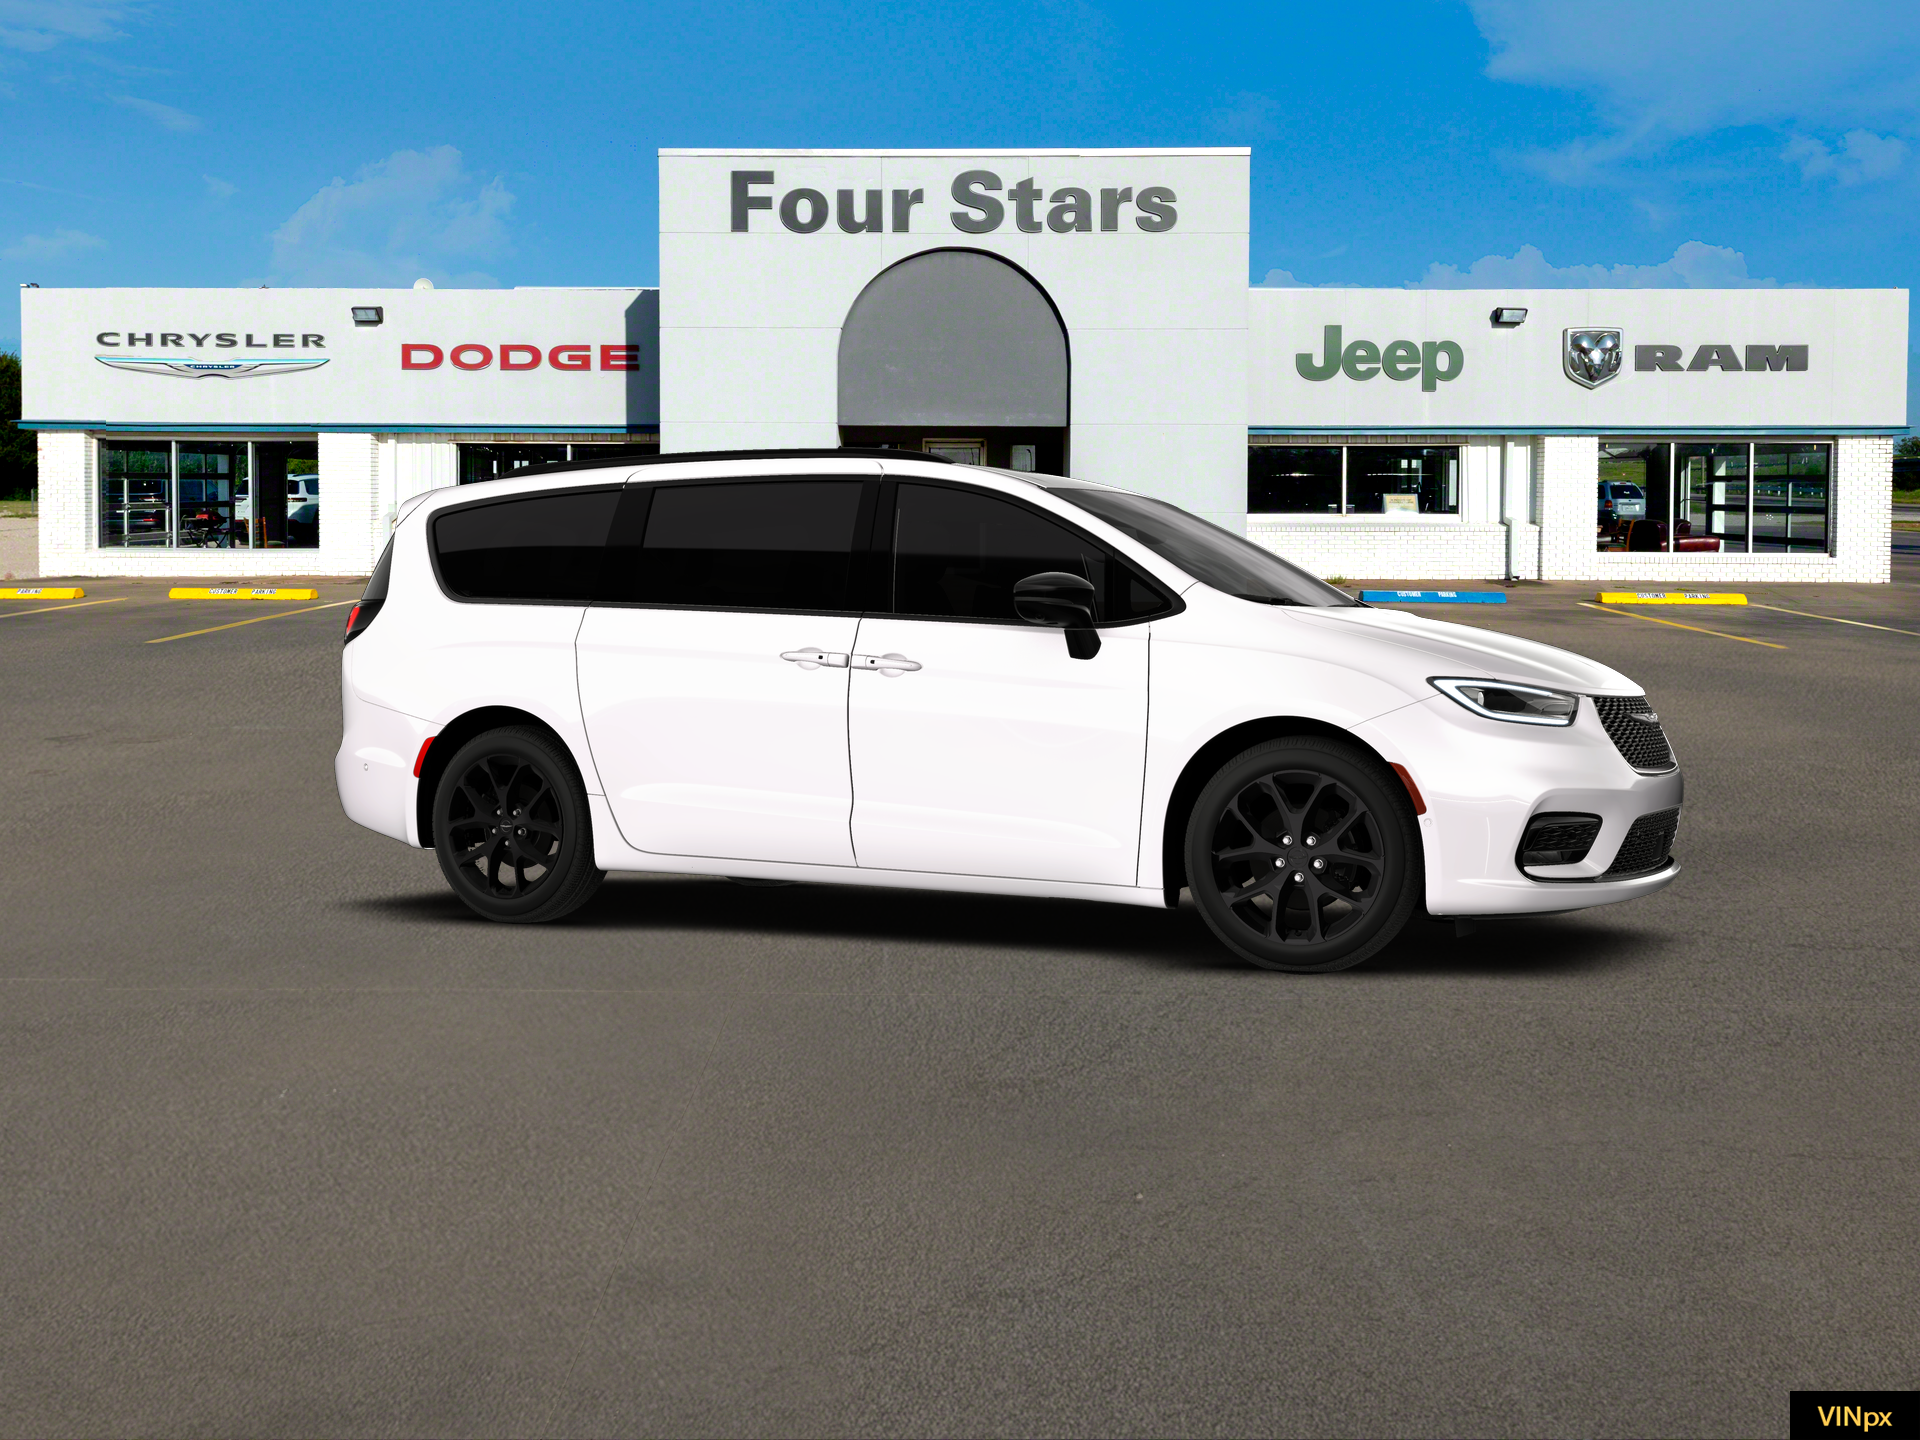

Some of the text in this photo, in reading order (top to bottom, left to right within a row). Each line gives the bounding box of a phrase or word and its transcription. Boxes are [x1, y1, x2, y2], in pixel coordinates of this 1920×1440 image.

[730, 168, 1179, 234] Four Stars
[96, 331, 327, 348] CHRYSLER
[401, 343, 641, 372] DODGE
[1295, 324, 1464, 392] Jeep
[1634, 343, 1810, 372] RAM
